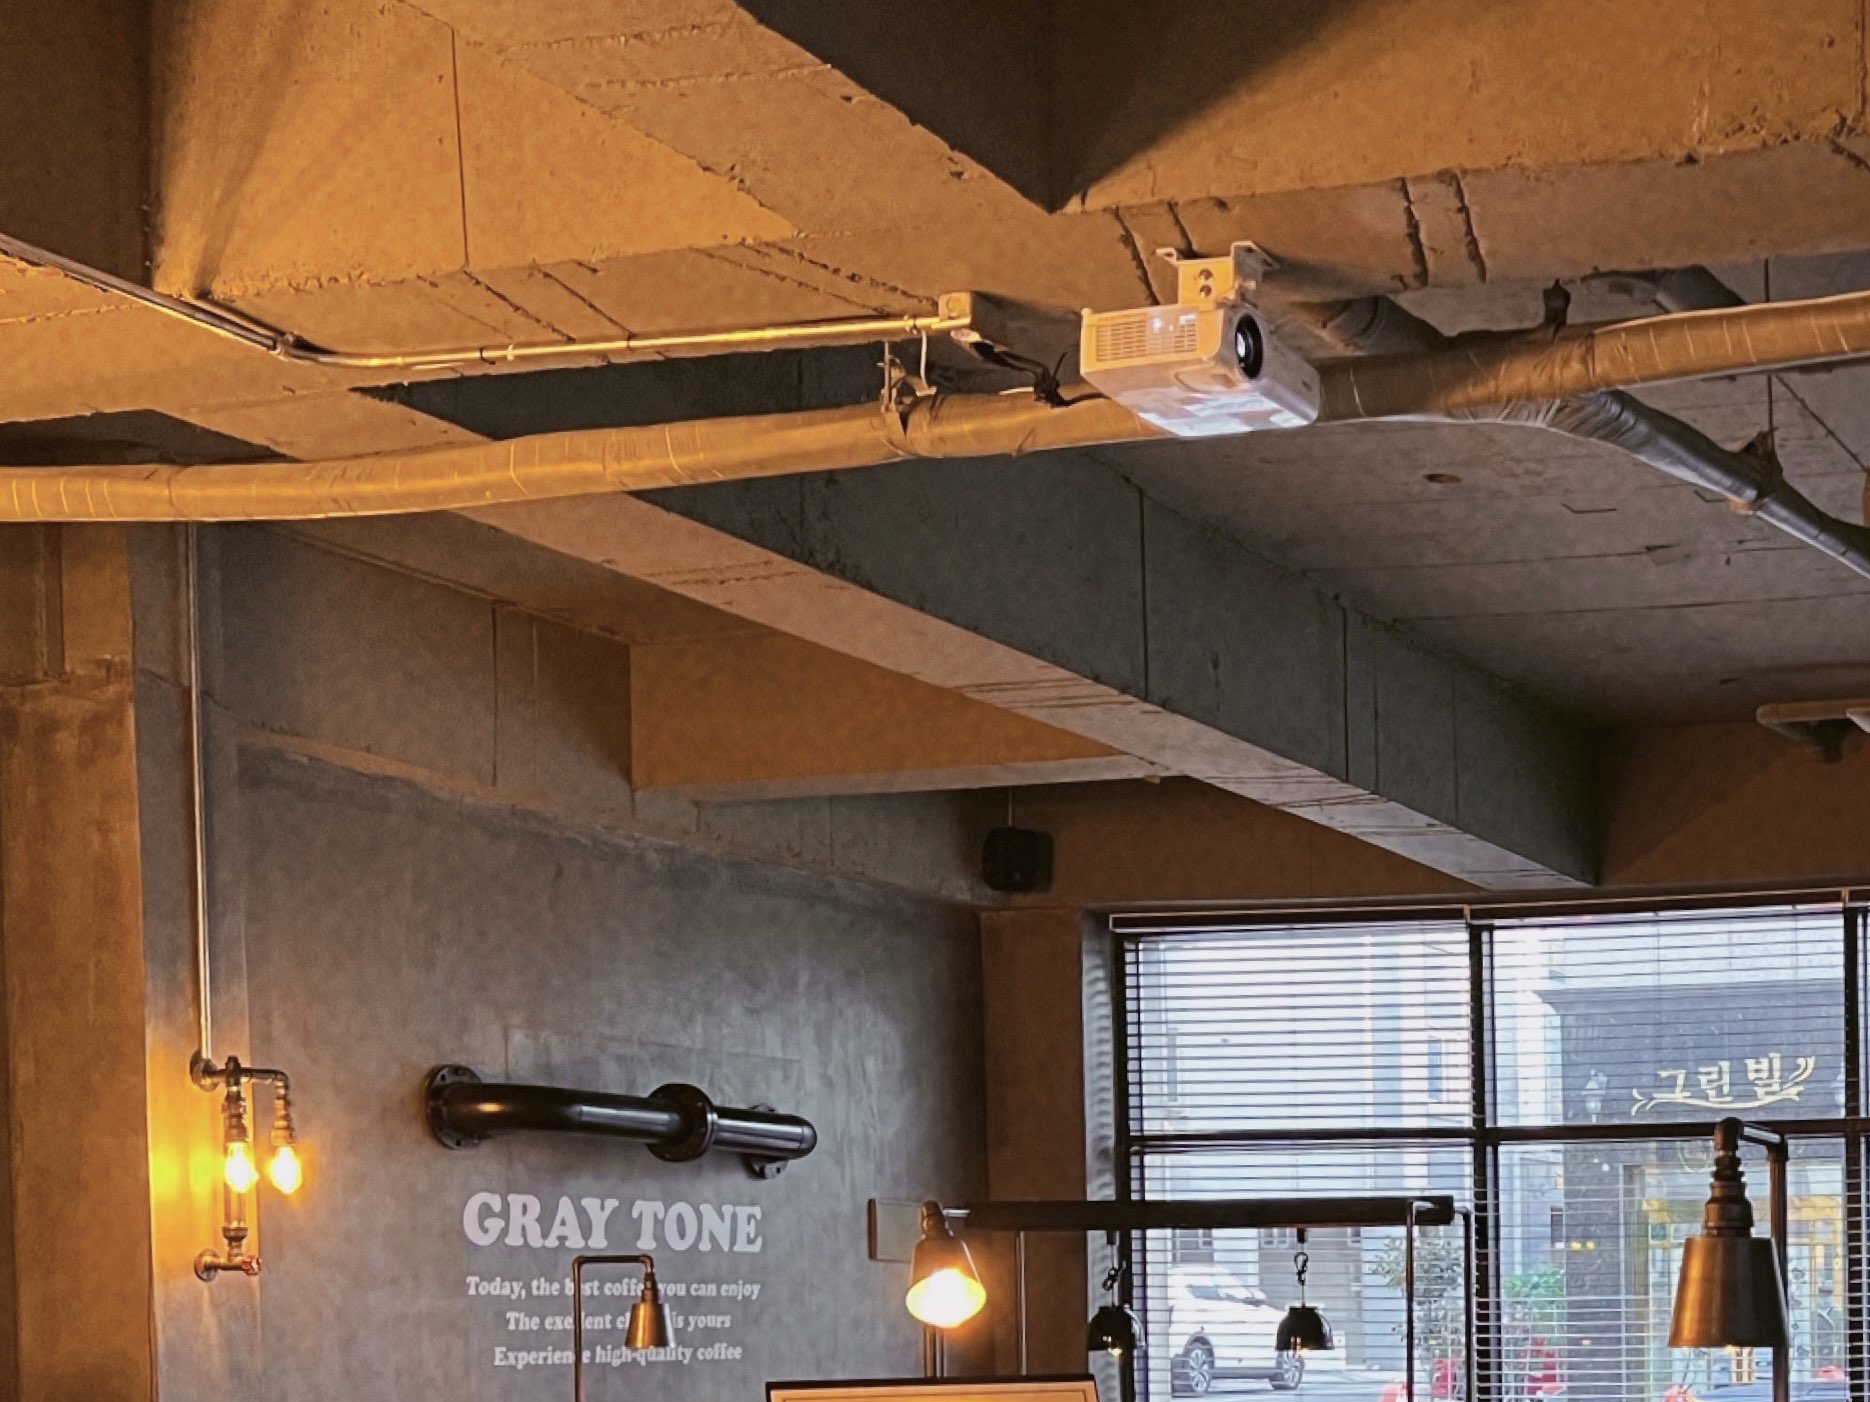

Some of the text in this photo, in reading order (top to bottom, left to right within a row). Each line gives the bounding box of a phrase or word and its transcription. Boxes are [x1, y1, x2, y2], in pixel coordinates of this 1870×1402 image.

[462, 1192, 763, 1253] GRAY TONE
[466, 1276, 761, 1301] Today, the bst coffe you can enjoy
[506, 1311, 539, 1331] The
[544, 1312, 612, 1331] exelent
[672, 1311, 684, 1329] is
[687, 1313, 731, 1333] yours
[494, 1344, 743, 1369] Experiene high-quality coffee
